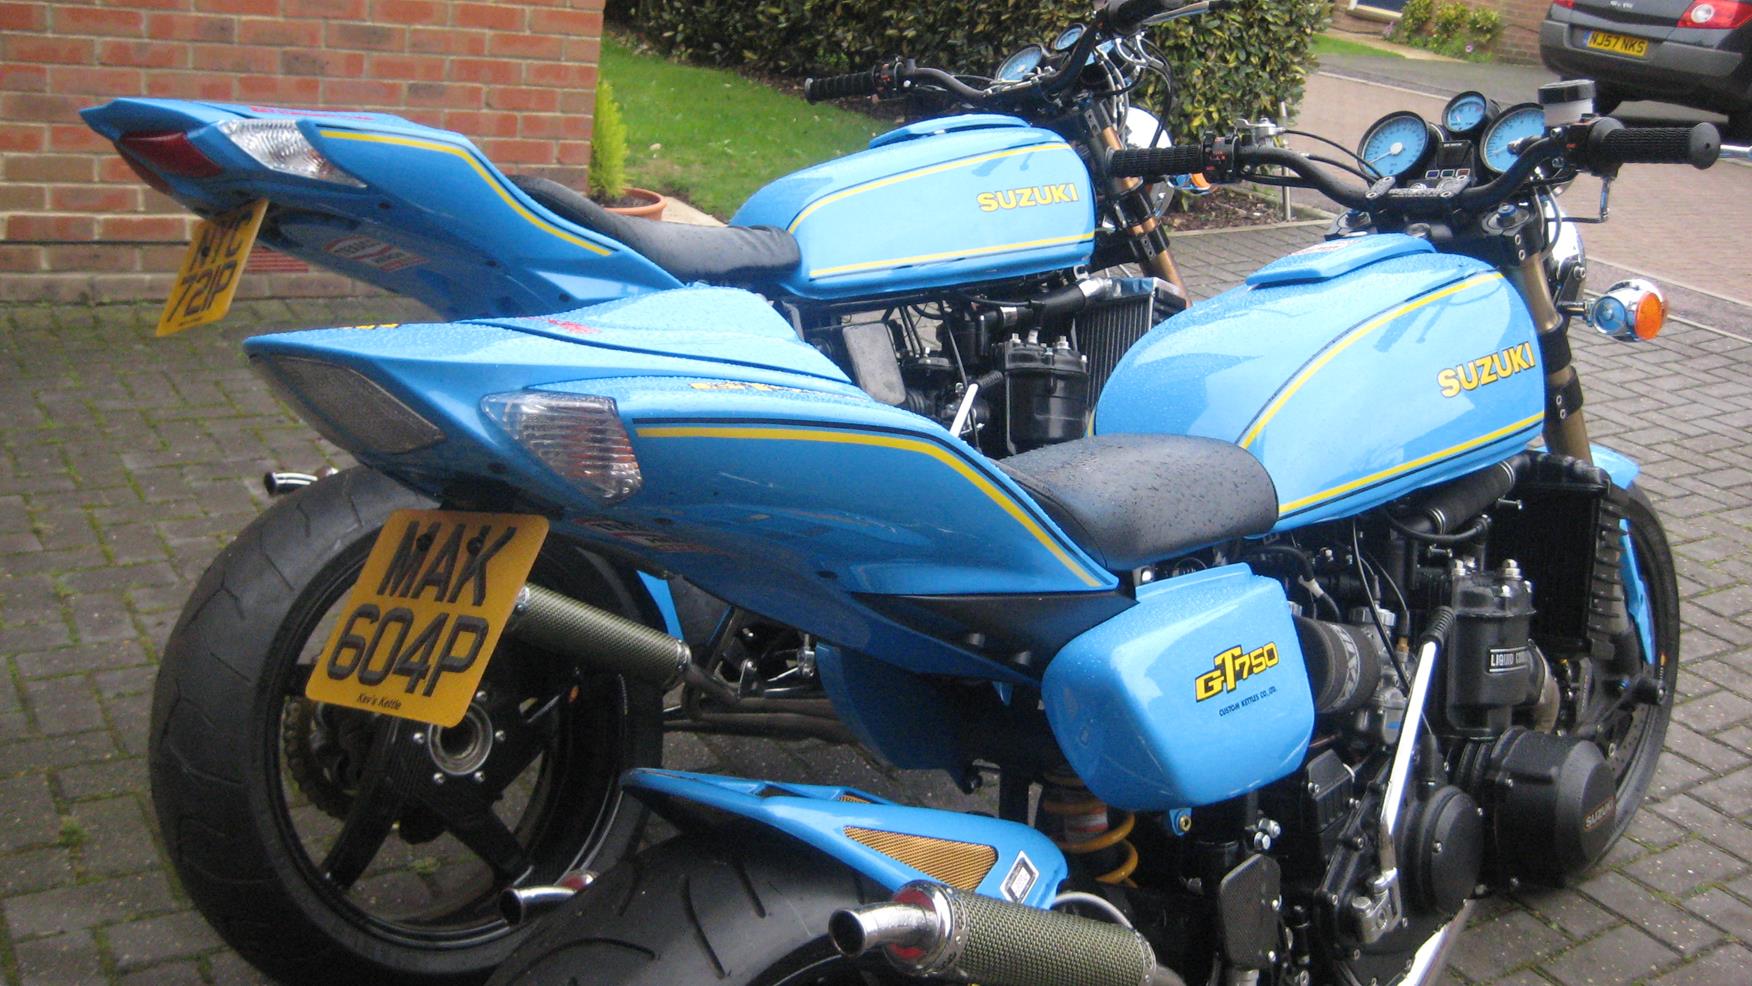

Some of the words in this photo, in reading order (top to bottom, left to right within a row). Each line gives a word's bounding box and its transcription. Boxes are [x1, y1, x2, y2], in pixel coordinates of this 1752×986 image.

[1589, 31, 1620, 48] NJ57
[1621, 38, 1646, 54] NKS
[976, 182, 1080, 213] SUZUKI
[167, 261, 238, 323] 721P
[1437, 341, 1536, 398] SUZUKI
[377, 520, 517, 607] MAK
[327, 603, 490, 698] 604P
[1195, 641, 1279, 702] GT750
[1490, 653, 1513, 667] LIQUID
[377, 696, 402, 711] Kettle
[1218, 702, 1240, 717] CUSTOM
[1240, 694, 1260, 707] KETTLES
